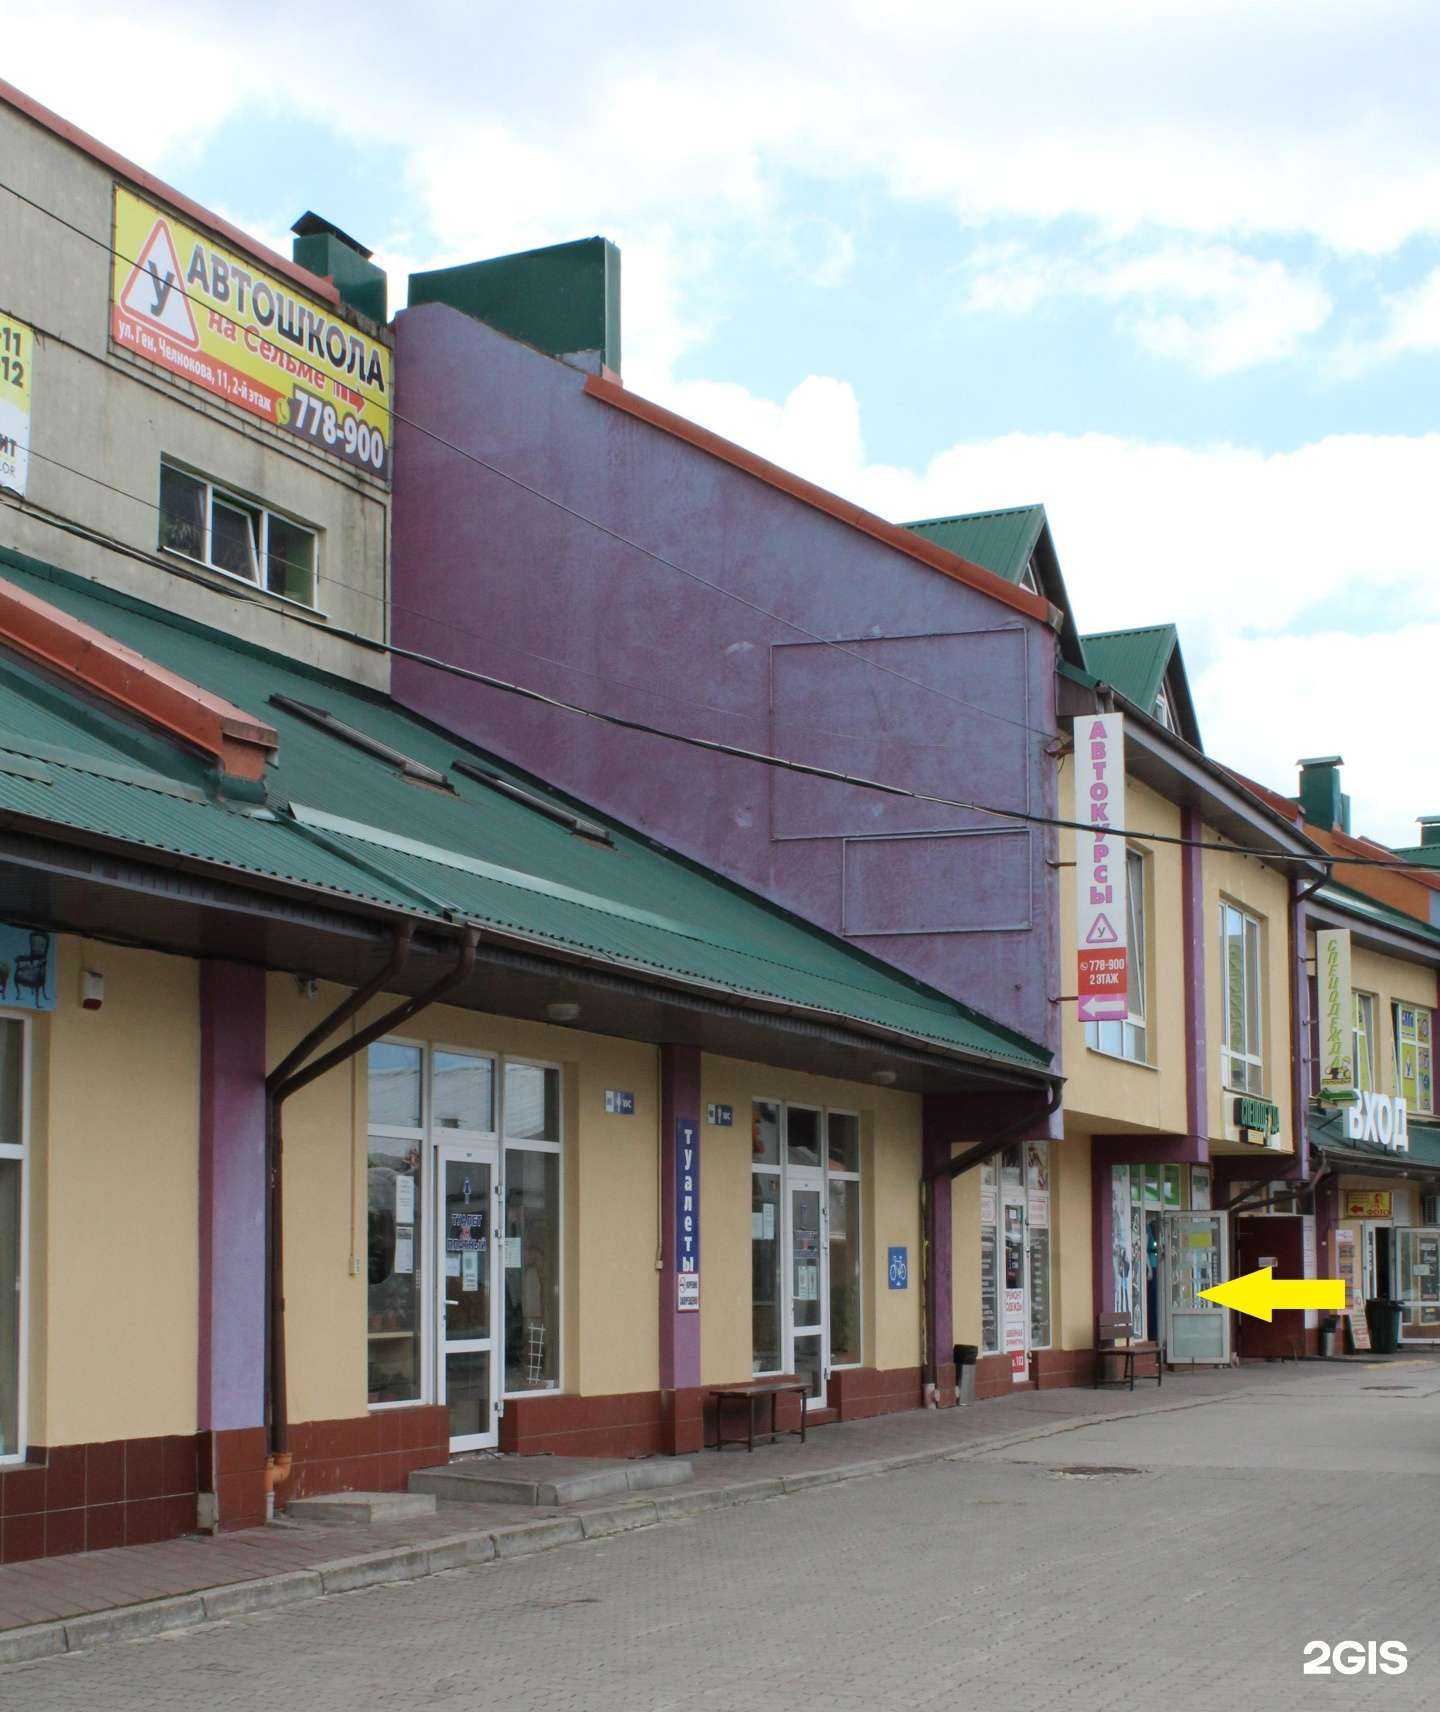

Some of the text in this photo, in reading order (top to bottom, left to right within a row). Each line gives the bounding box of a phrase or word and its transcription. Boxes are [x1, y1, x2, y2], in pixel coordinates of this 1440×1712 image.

[0, 327, 21, 357] 11
[187, 244, 385, 393] АВТОШКОЛА
[208, 311, 326, 390] на Сельме
[118, 320, 272, 413] ул. Ген. Челнокова, 11, 2-й этаж
[294, 388, 384, 469] 778-900
[1089, 721, 1113, 905] АВТОКУРСЫ
[1088, 959, 1125, 971] 778-900
[1089, 973, 1120, 985] 2 ЭТАЖ
[1349, 1089, 1408, 1151] ВХОД
